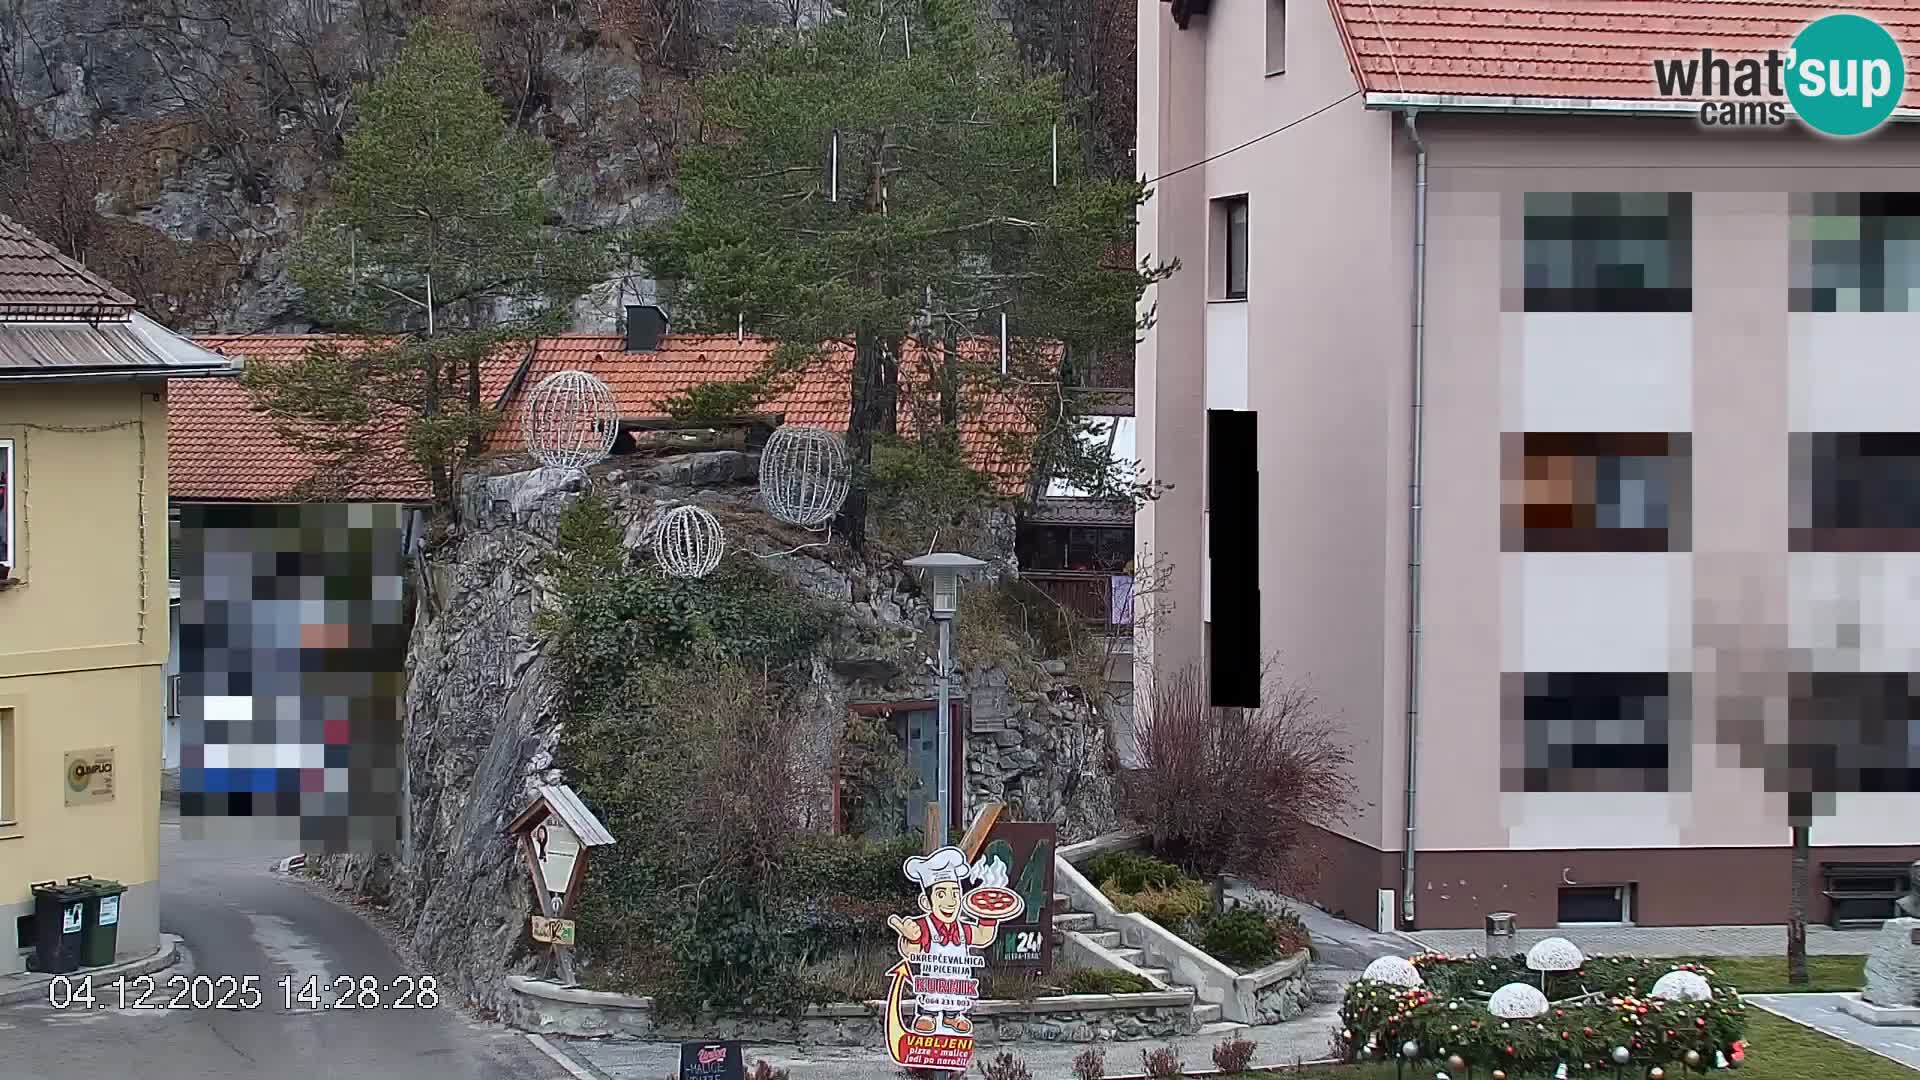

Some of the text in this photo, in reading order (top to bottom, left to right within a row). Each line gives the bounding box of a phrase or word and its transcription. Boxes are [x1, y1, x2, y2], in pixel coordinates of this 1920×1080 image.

[910, 953, 984, 966] OKREPČEVALNICA
[922, 964, 970, 975] IN PICERIJA
[915, 977, 978, 996] KURNIK
[907, 1035, 973, 1049] VABLJENI
[909, 1047, 969, 1057] pizze malice
[904, 1055, 922, 1064] jedi
[923, 1057, 935, 1065] po
